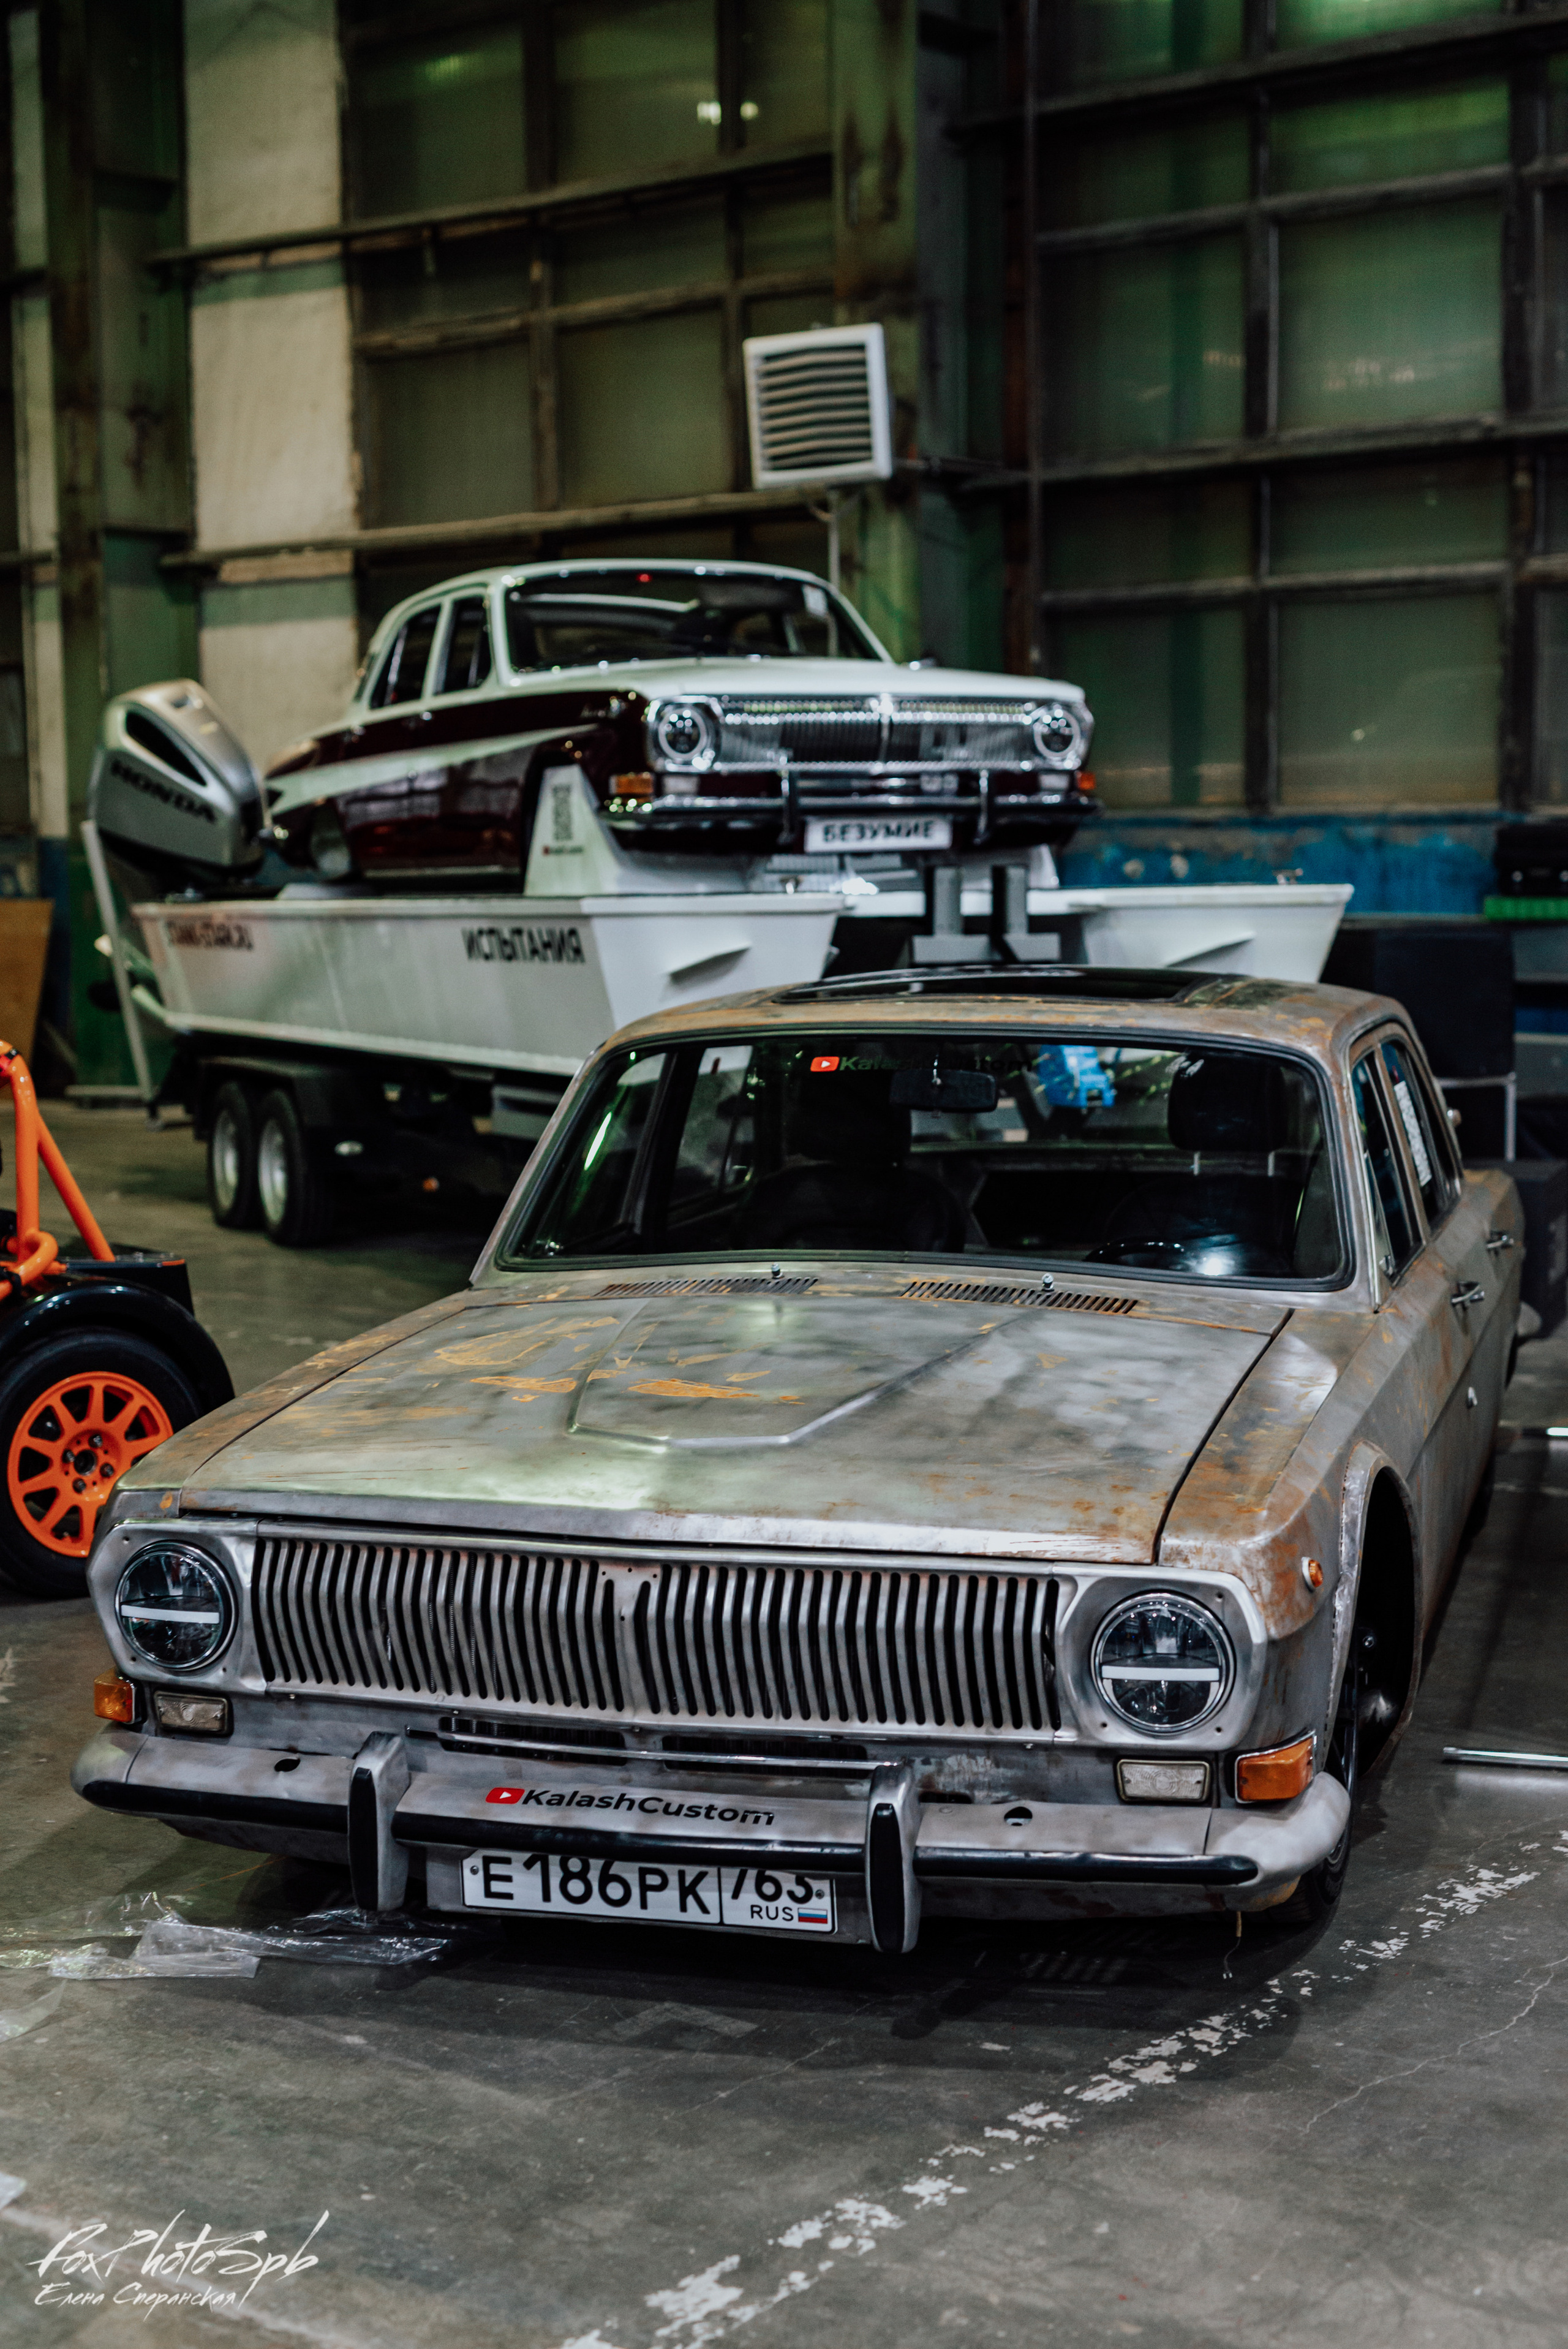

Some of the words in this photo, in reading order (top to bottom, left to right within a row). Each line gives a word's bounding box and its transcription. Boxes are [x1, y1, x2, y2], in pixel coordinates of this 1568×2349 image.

[110, 759, 217, 823] HONDA
[823, 819, 936, 843] БЕЗУМИЕ
[461, 926, 586, 964] ИСПЫТАНИЯ
[522, 1789, 775, 1826] KalashCustom
[750, 1904, 794, 1922] RUS
